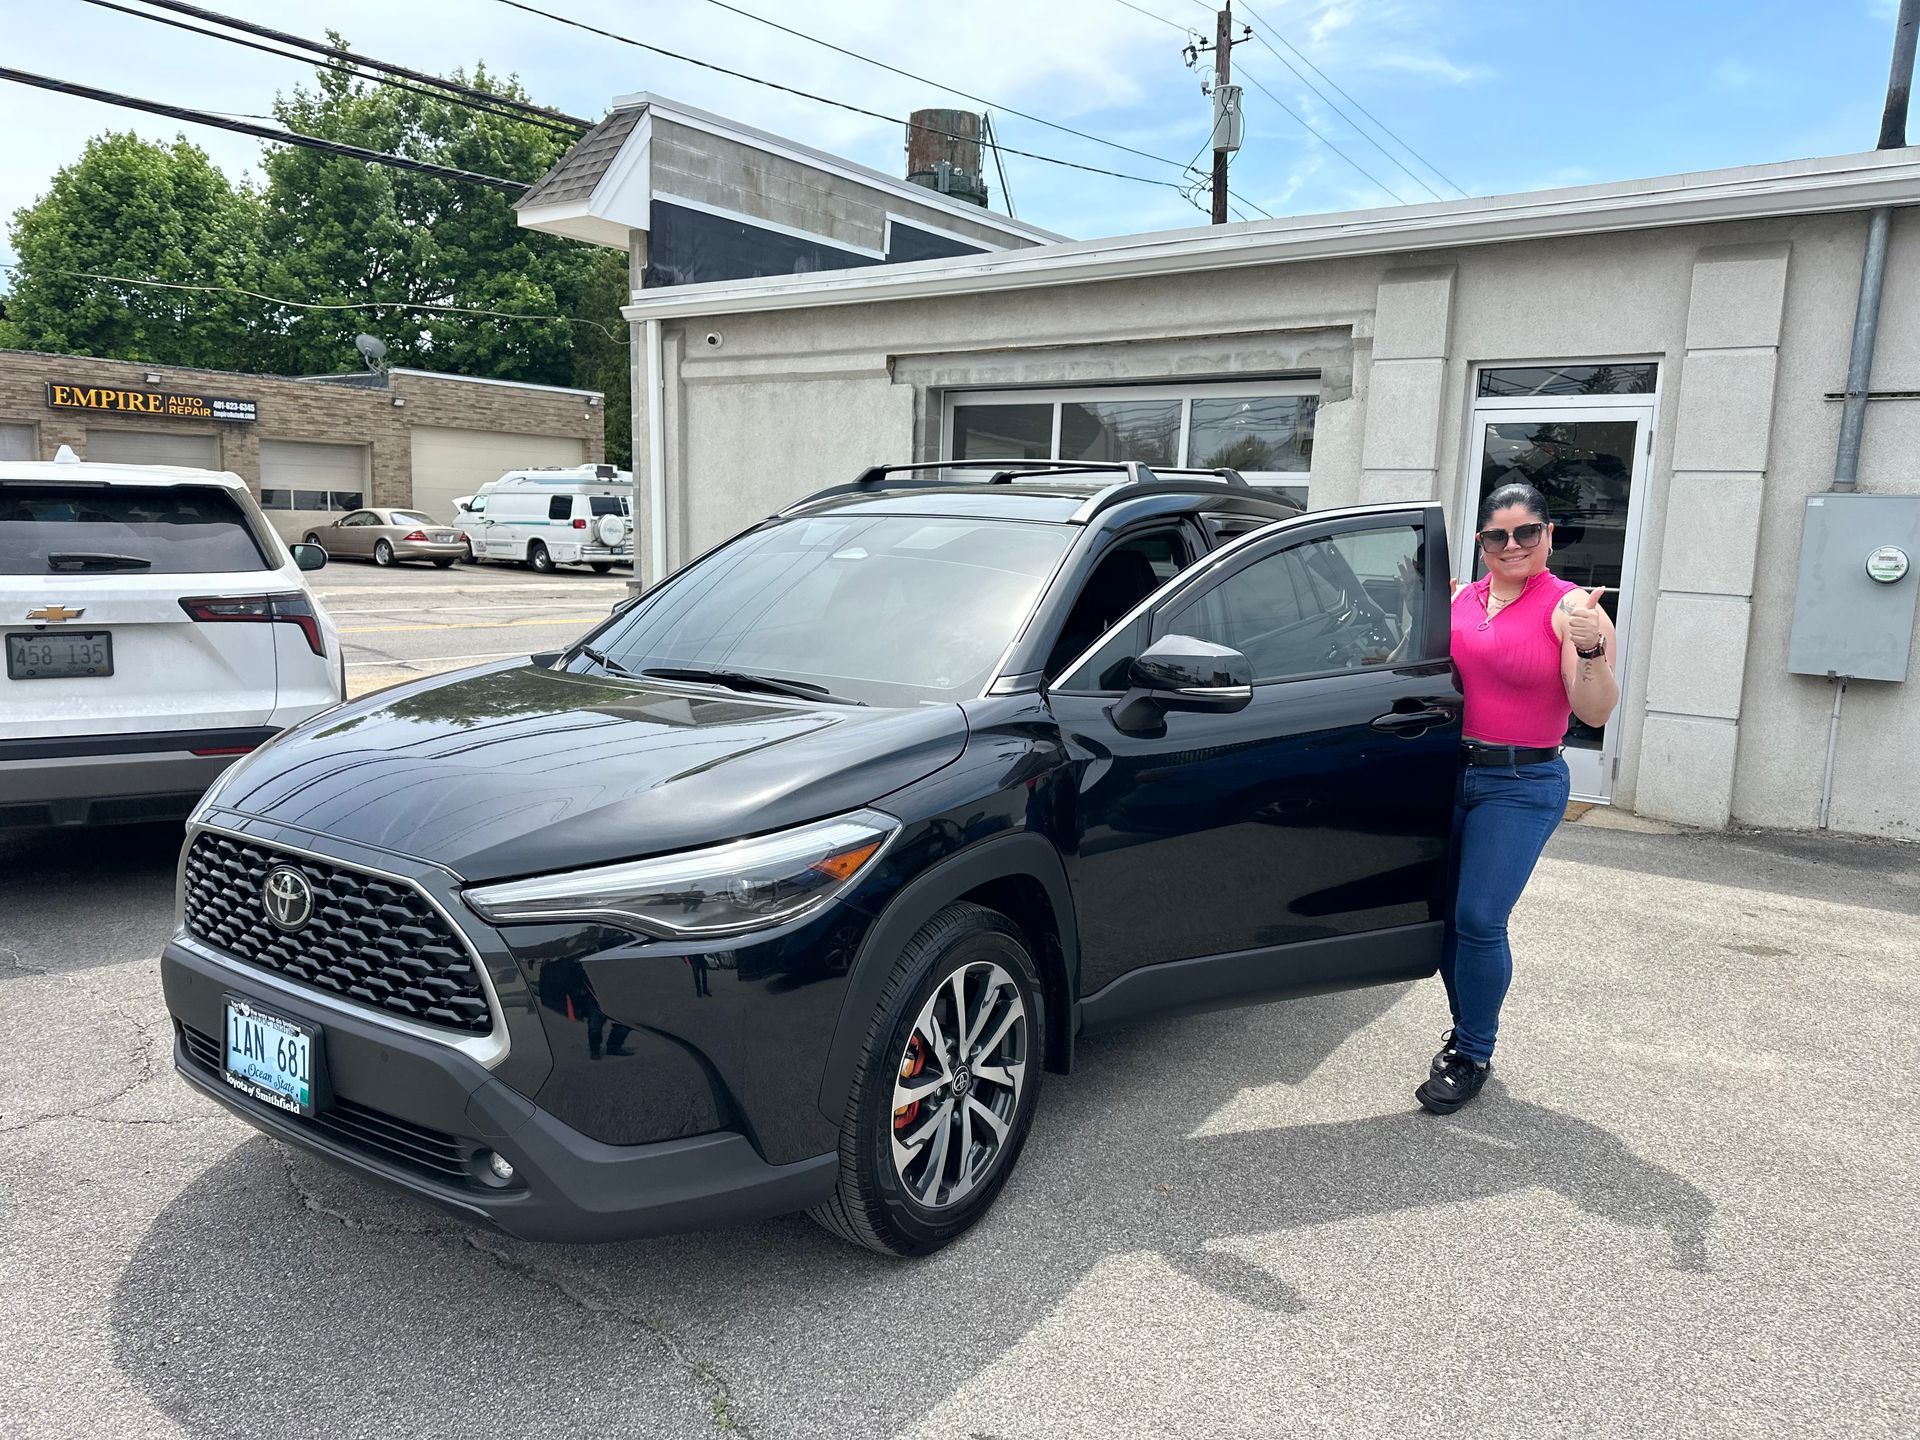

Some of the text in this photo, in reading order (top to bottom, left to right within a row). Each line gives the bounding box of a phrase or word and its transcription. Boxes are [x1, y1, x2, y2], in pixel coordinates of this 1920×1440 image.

[53, 386, 164, 413] EMPIRE
[168, 396, 203, 407] AUTO
[168, 405, 211, 417] REPAIR
[16, 643, 104, 666] 458 135
[277, 1036, 309, 1083] 681
[247, 1063, 295, 1094] Ocean State
[226, 1072, 300, 1115] Toyota of Smithfield
